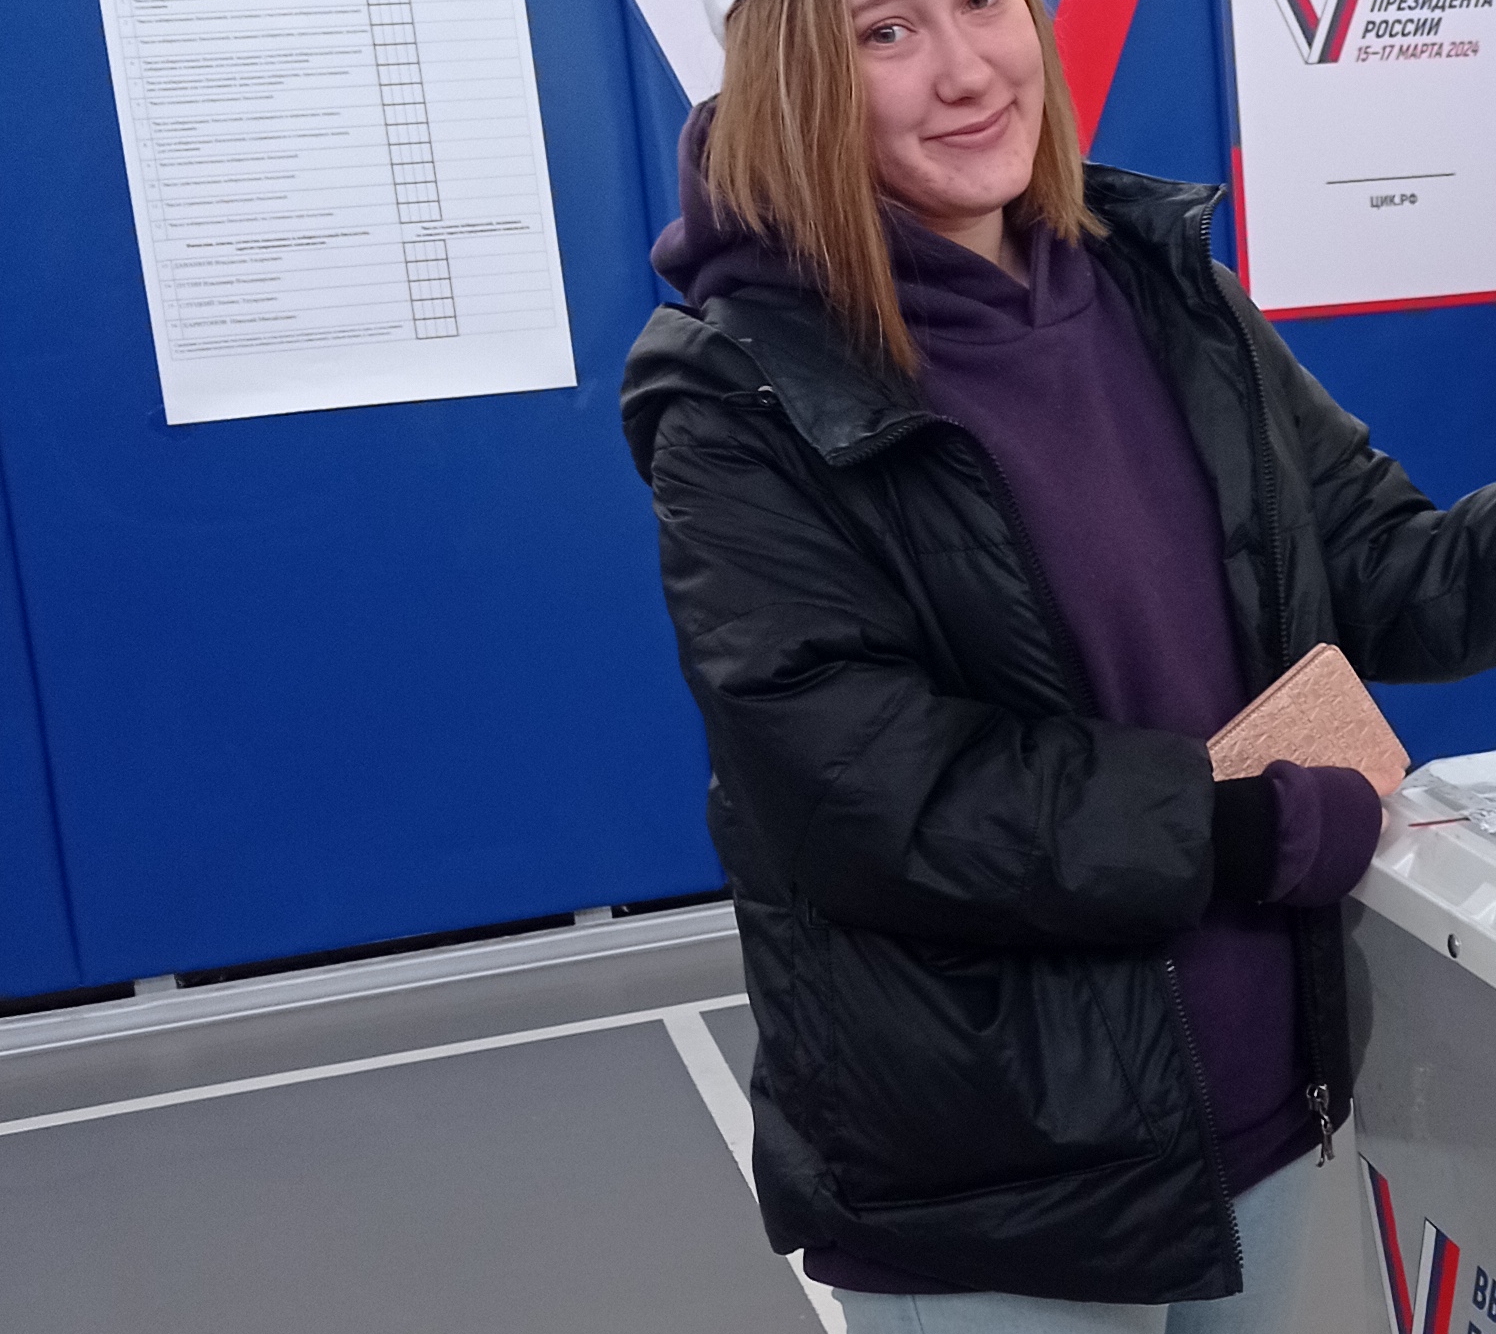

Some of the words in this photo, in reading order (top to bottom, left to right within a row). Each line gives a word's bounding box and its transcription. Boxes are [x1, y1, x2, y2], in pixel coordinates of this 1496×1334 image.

[1361, 16, 1443, 41] РОССИИ
[1396, 42, 1445, 62] МАРТА
[1448, 40, 1481, 59] 2024
[1369, 192, 1418, 210] ЦИК.РФ
